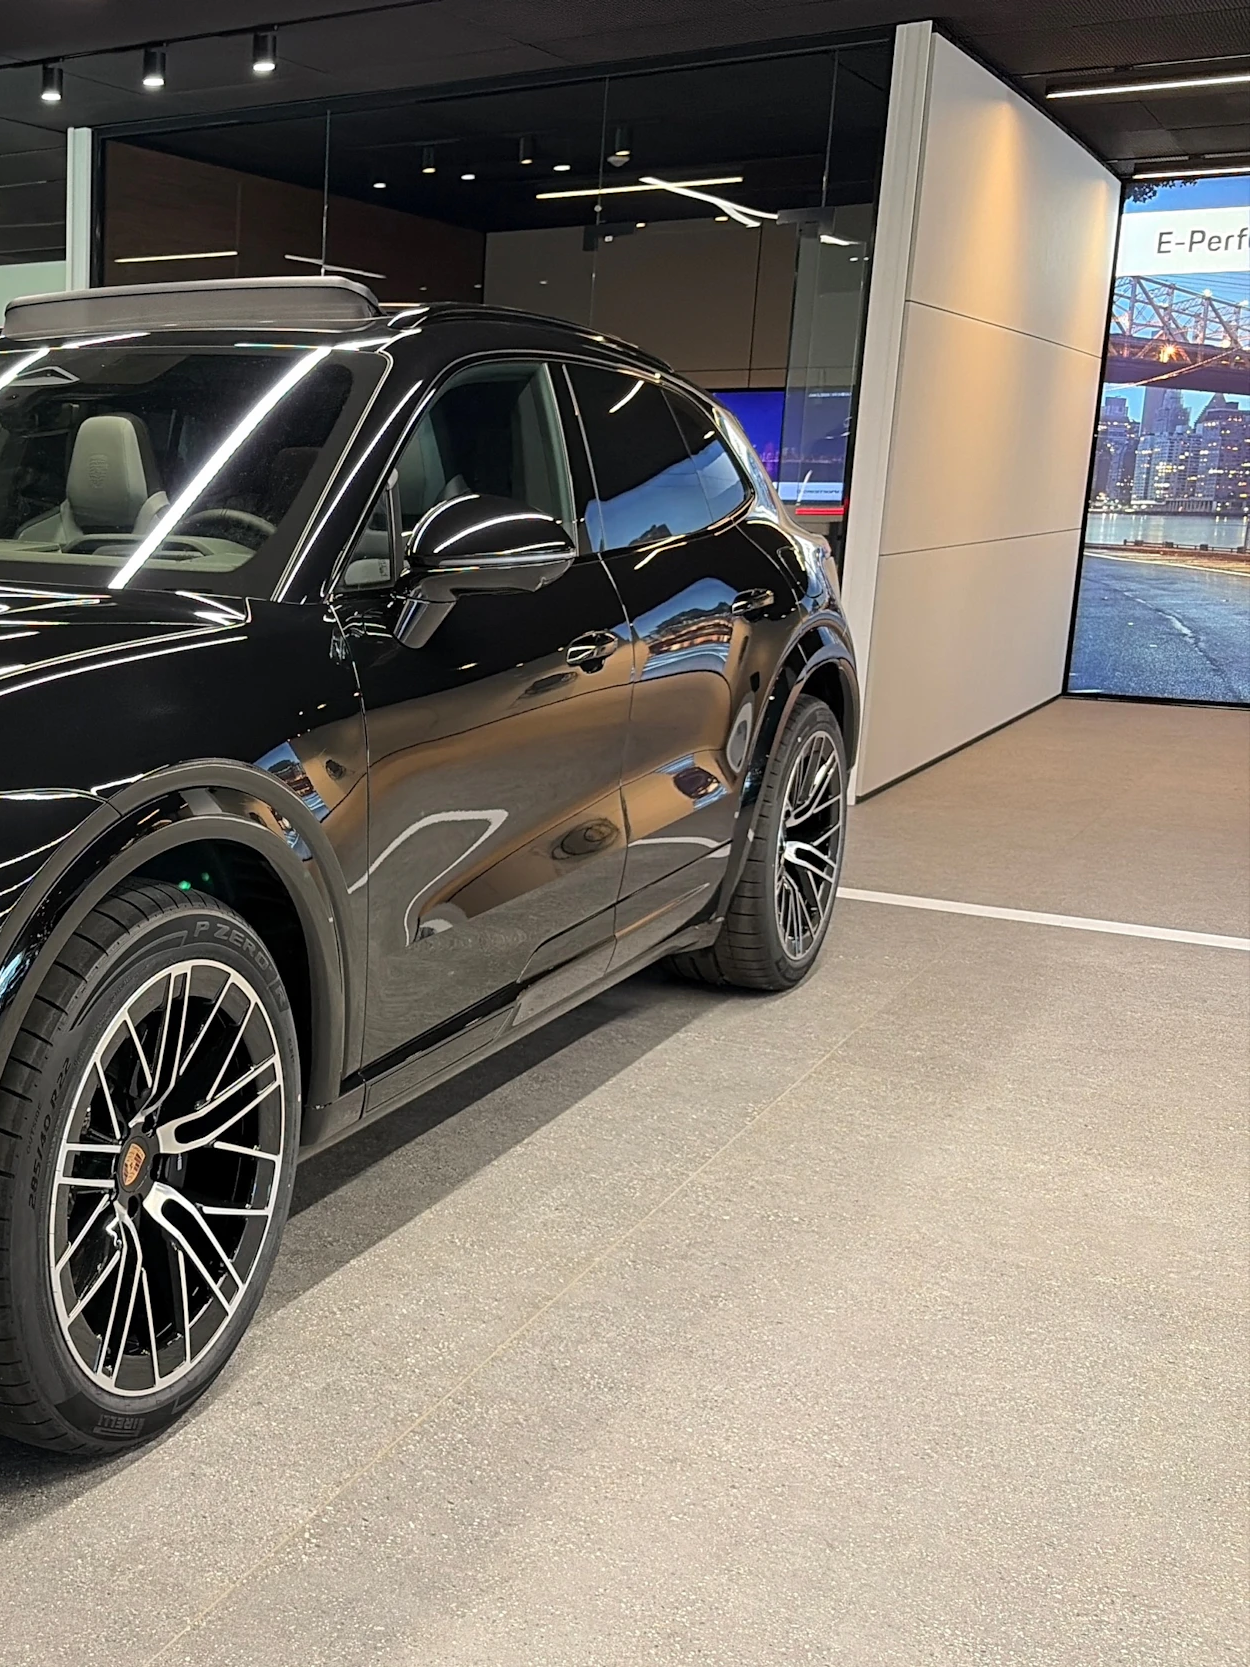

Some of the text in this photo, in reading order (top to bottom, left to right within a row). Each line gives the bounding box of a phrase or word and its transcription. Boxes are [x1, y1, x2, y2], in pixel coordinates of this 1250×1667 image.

[1157, 227, 1250, 254] E-Perf
[193, 921, 270, 971] P ZERO
[93, 1414, 145, 1438] PIRELLI
